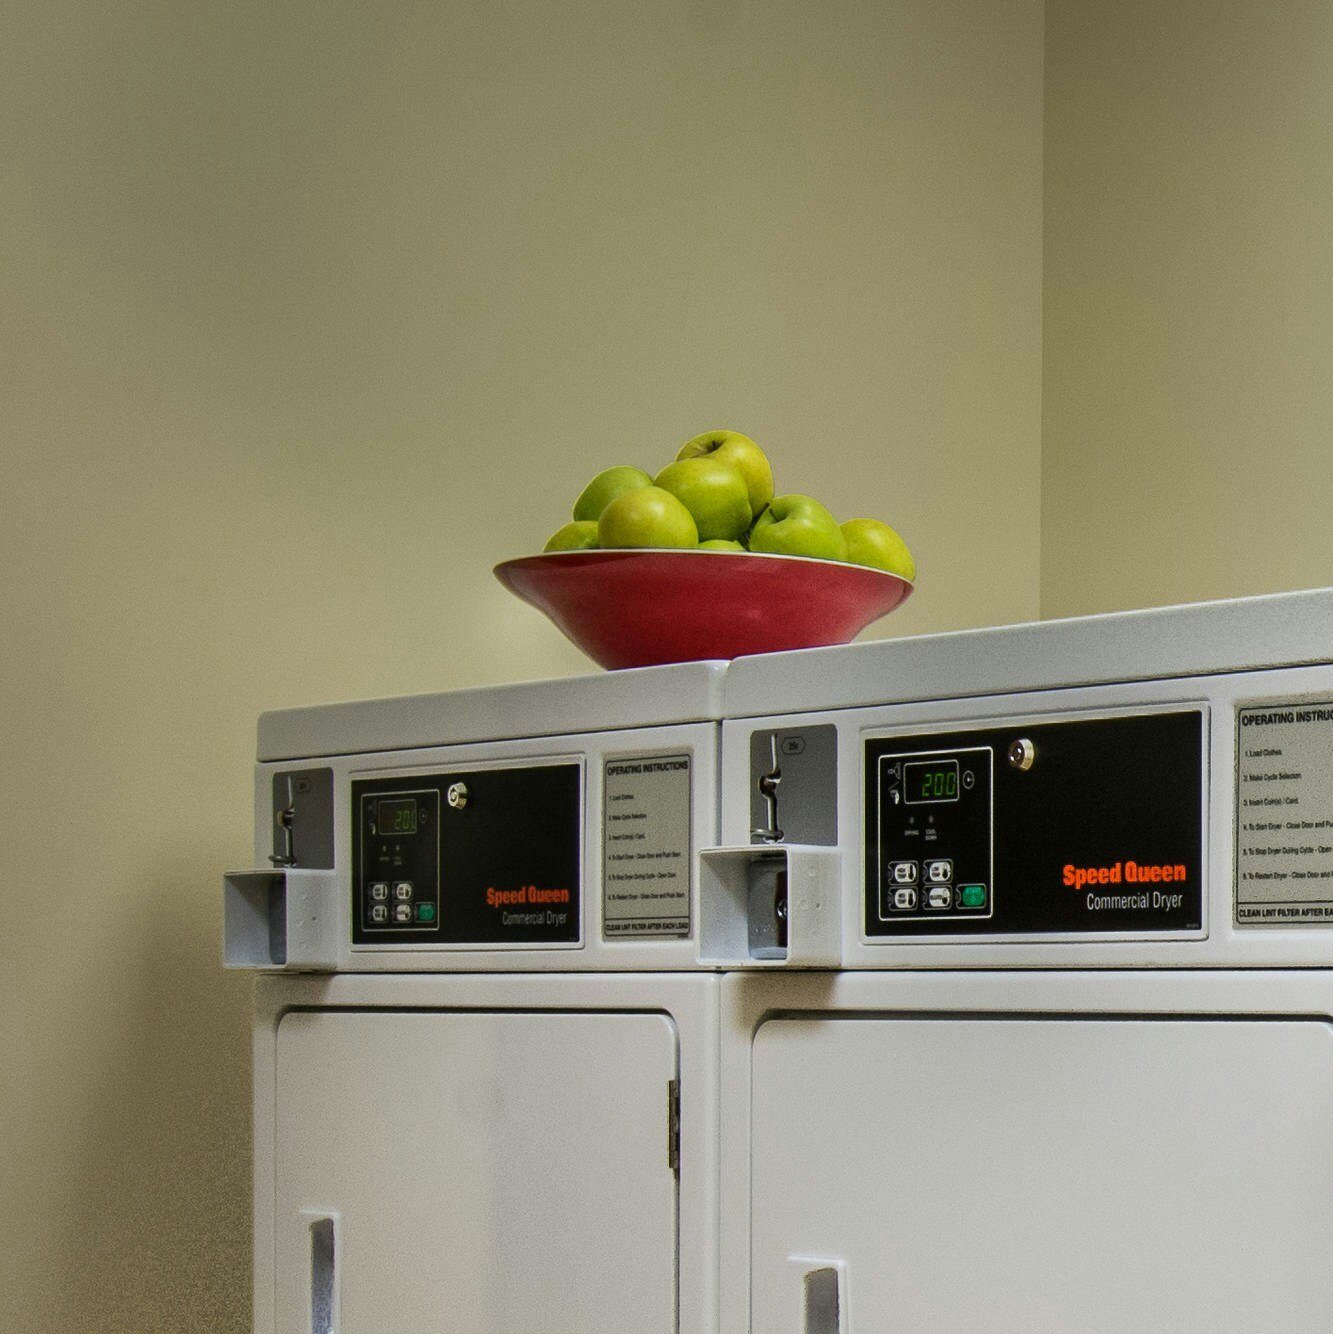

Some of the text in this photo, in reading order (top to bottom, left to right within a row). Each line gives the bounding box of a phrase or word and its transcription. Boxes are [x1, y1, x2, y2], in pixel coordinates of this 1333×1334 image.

[1242, 713, 1294, 726] OPERATING
[608, 761, 688, 776] OPERATING INSTRUCTIONS
[922, 772, 956, 796] 200
[1063, 860, 1186, 890] Speed Queen
[486, 885, 569, 908] Speed Queen
[1087, 892, 1184, 912] Commercial Dryer
[502, 910, 568, 926] Commercial Dryer
[1302, 908, 1322, 916] AFTER
